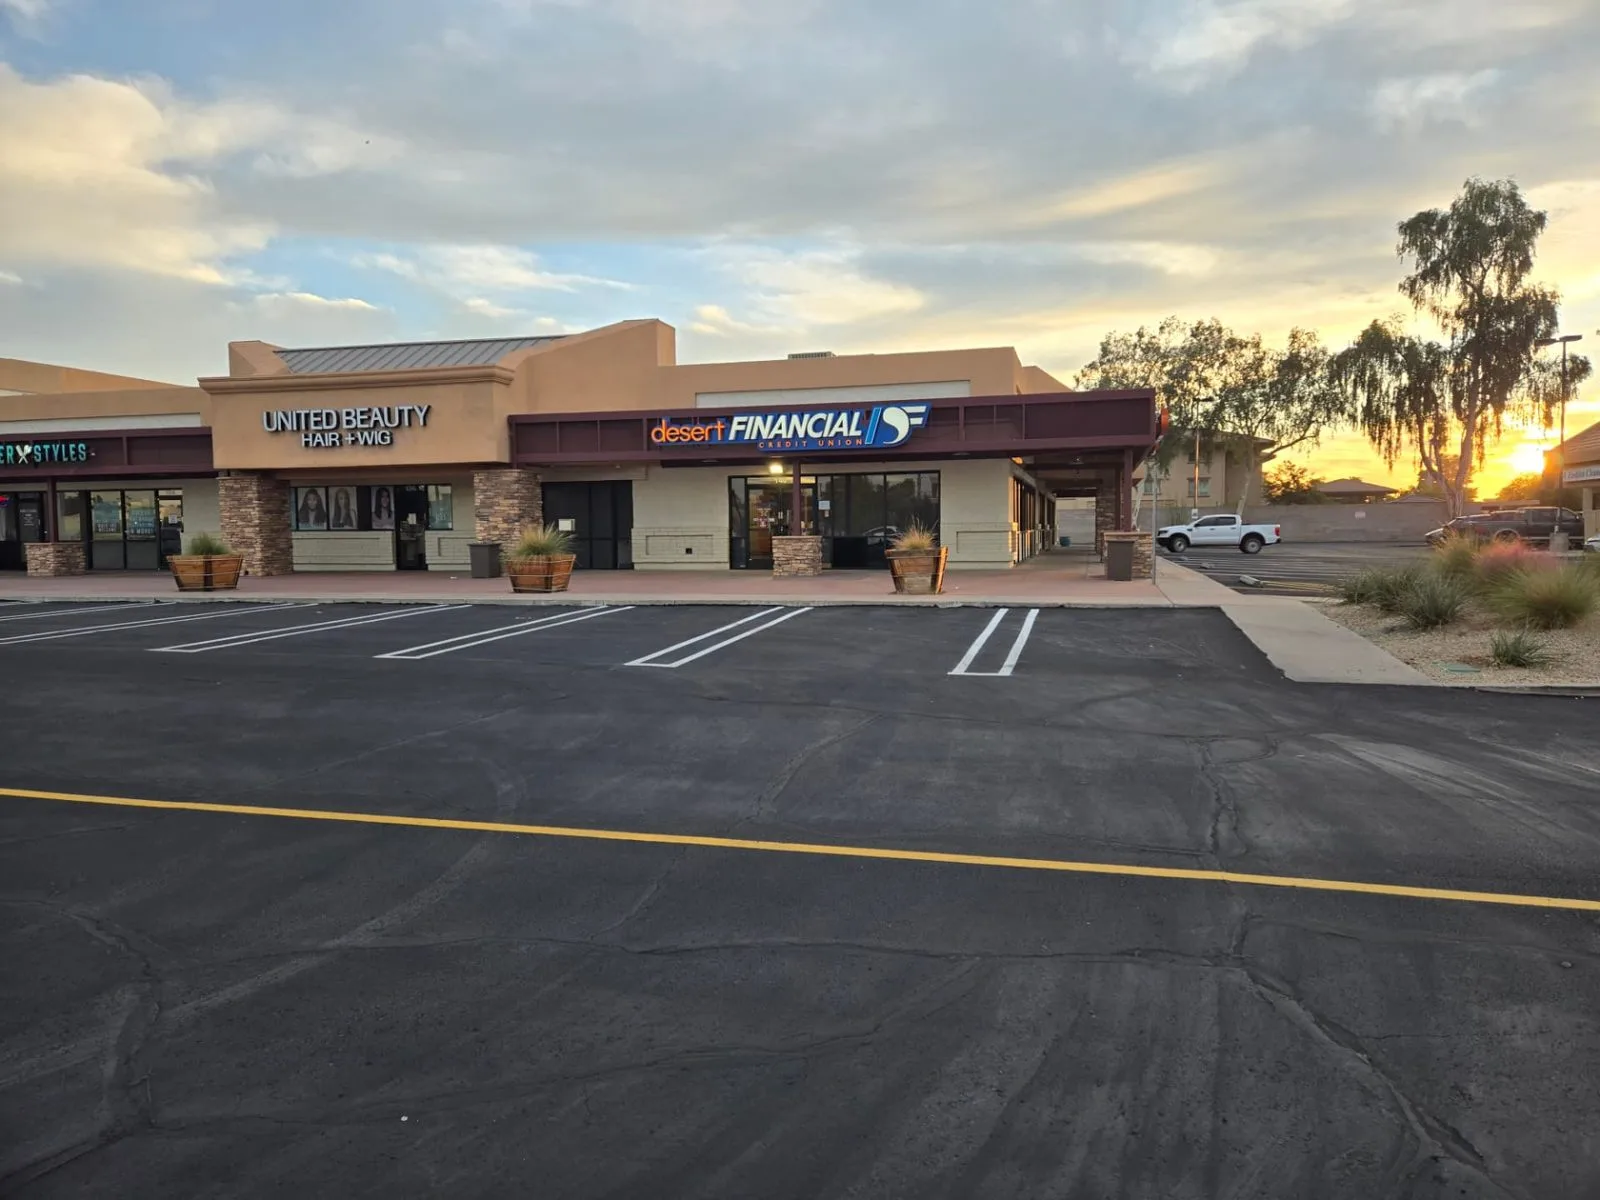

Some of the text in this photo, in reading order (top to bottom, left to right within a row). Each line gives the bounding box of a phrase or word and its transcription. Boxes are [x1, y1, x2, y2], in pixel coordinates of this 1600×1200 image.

[262, 405, 430, 432] UNITED BEAUTY
[651, 412, 862, 443] desert FINANCIAL
[301, 432, 340, 447] HAIR
[759, 438, 863, 449] CREDIT UNION
[33, 443, 87, 463] STYLES
